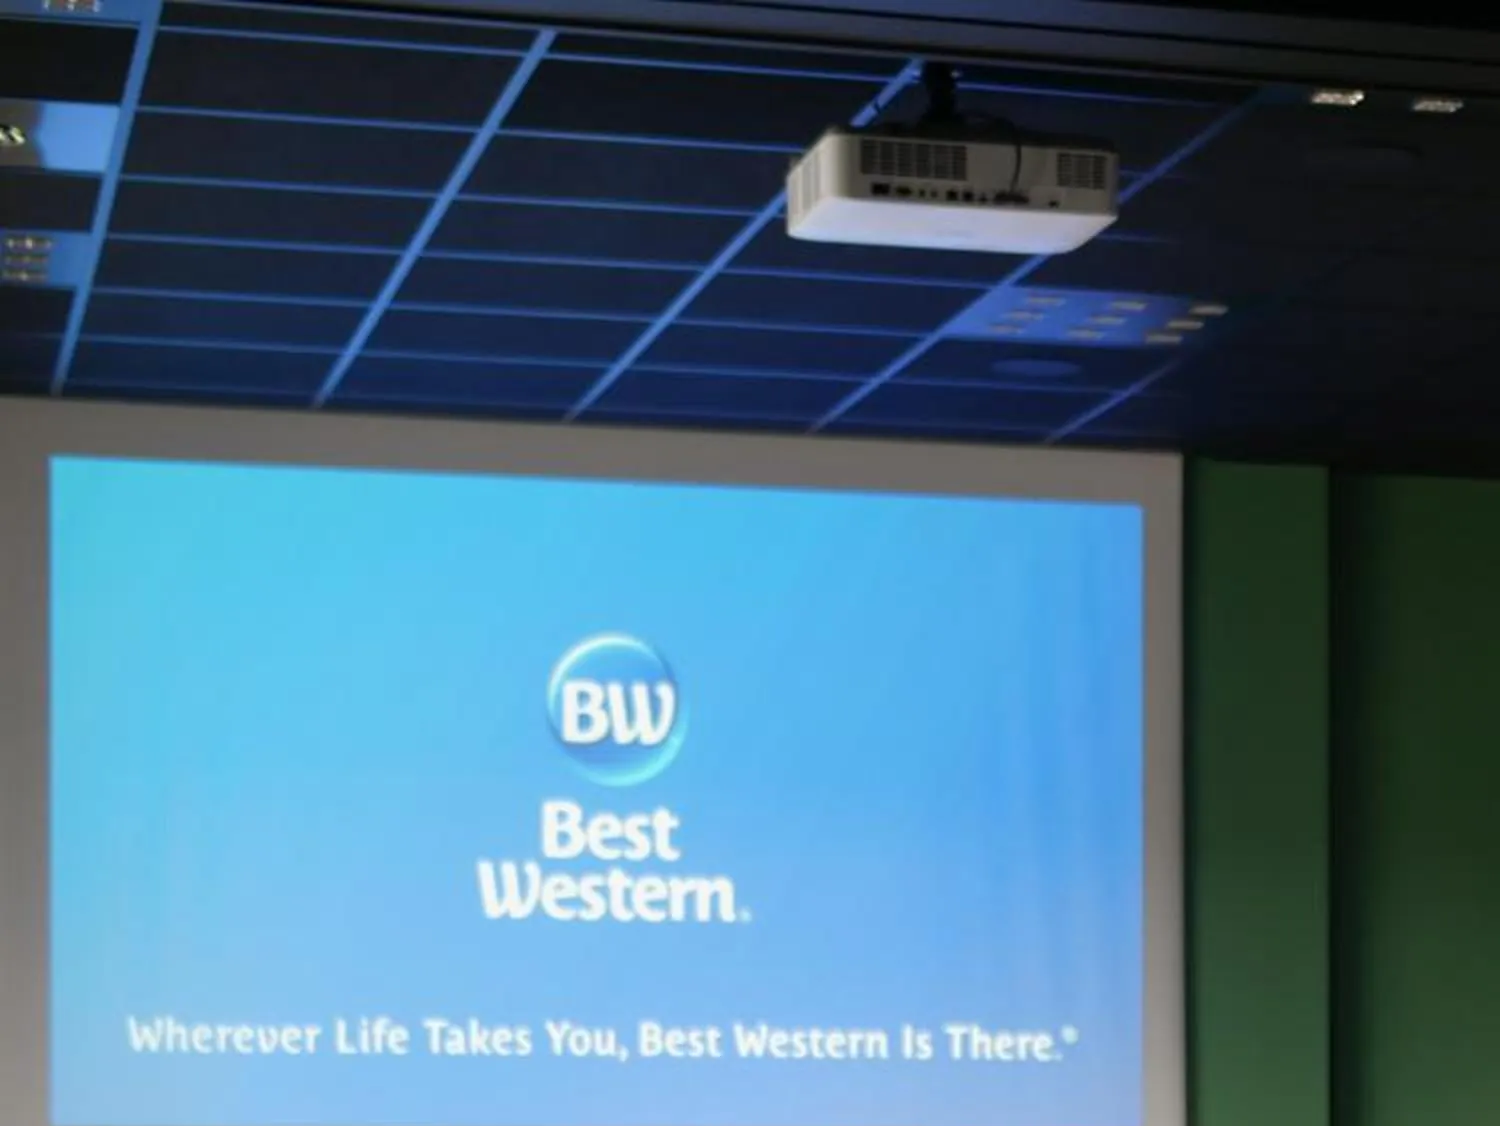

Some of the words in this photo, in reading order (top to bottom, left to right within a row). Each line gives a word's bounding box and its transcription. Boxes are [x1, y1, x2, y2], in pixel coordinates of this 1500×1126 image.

[561, 680, 675, 745] BW
[542, 800, 681, 861] Best
[128, 1016, 321, 1054] Wherever
[335, 1017, 409, 1055] Life
[423, 1019, 533, 1056] Takes
[545, 1020, 628, 1062] You,
[639, 1021, 721, 1058] Best
[733, 1023, 888, 1059] Western
[902, 1024, 933, 1060] Is
